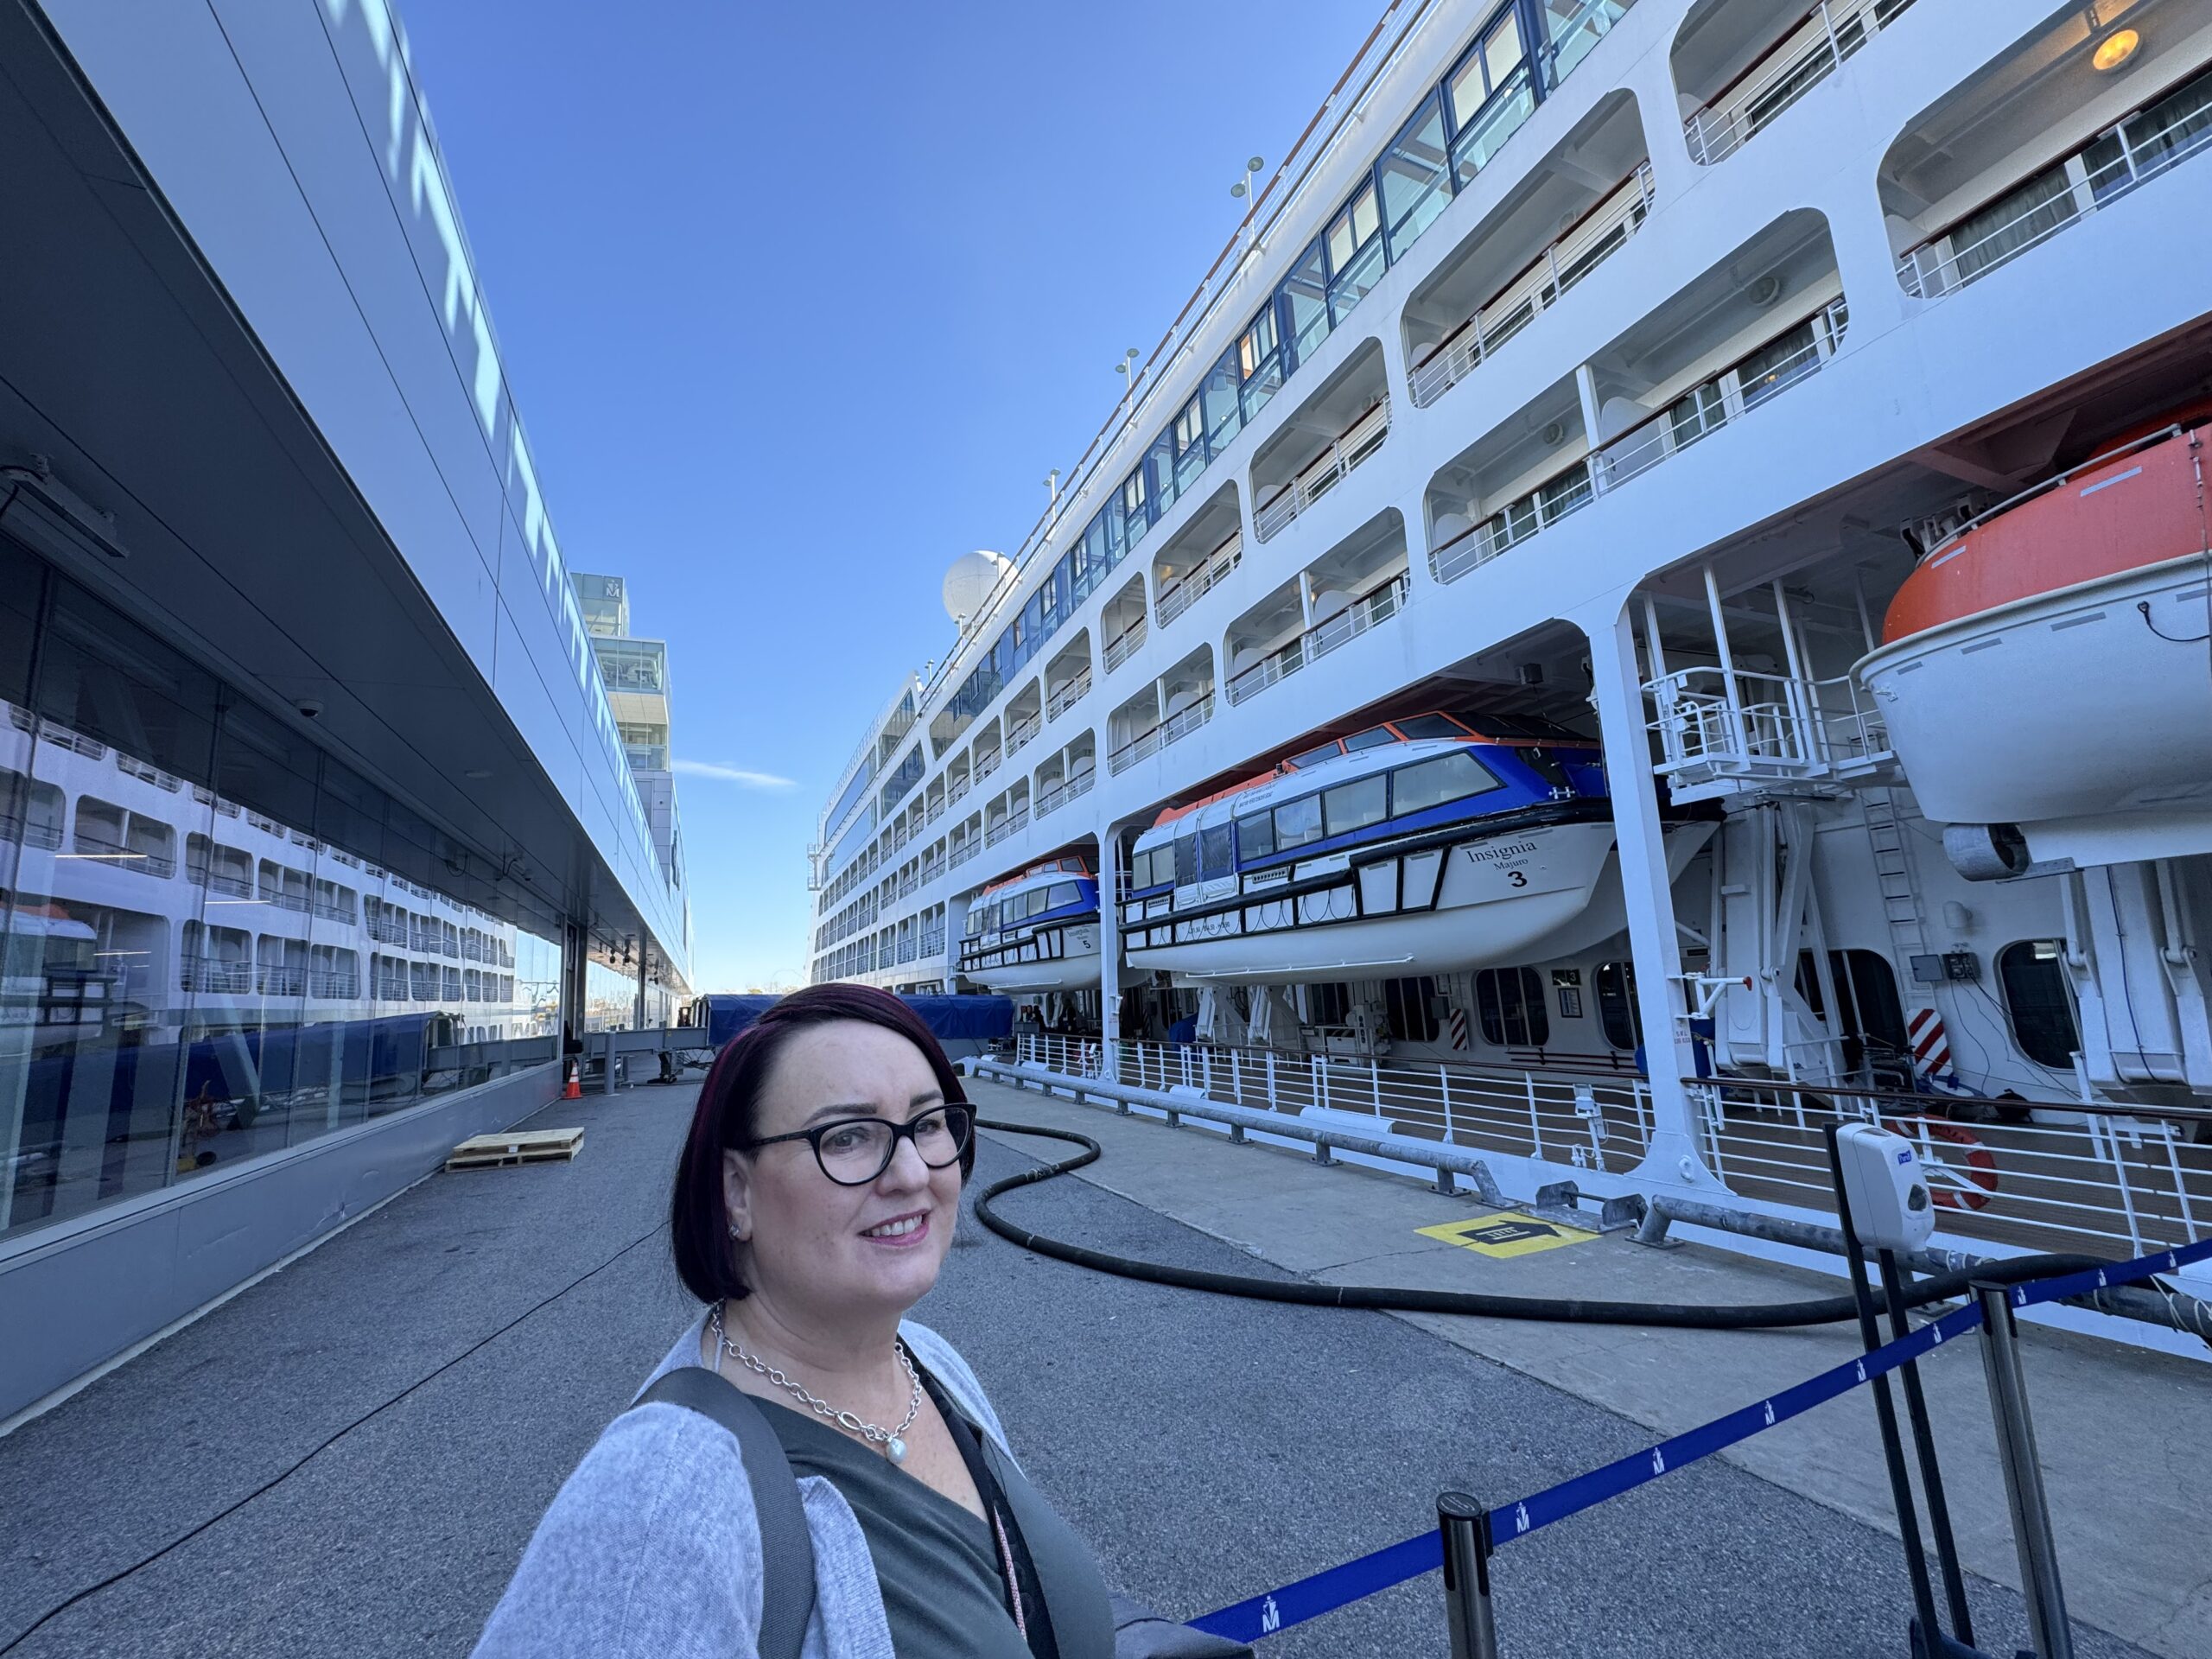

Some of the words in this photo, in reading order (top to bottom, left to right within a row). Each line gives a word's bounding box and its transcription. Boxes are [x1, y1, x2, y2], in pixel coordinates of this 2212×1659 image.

[1466, 840, 1537, 863] Insignia
[1493, 856, 1529, 871] Majuro
[1507, 871, 1528, 887] 3
[1083, 940, 1091, 949] 5
[1569, 972, 1577, 982] 3
